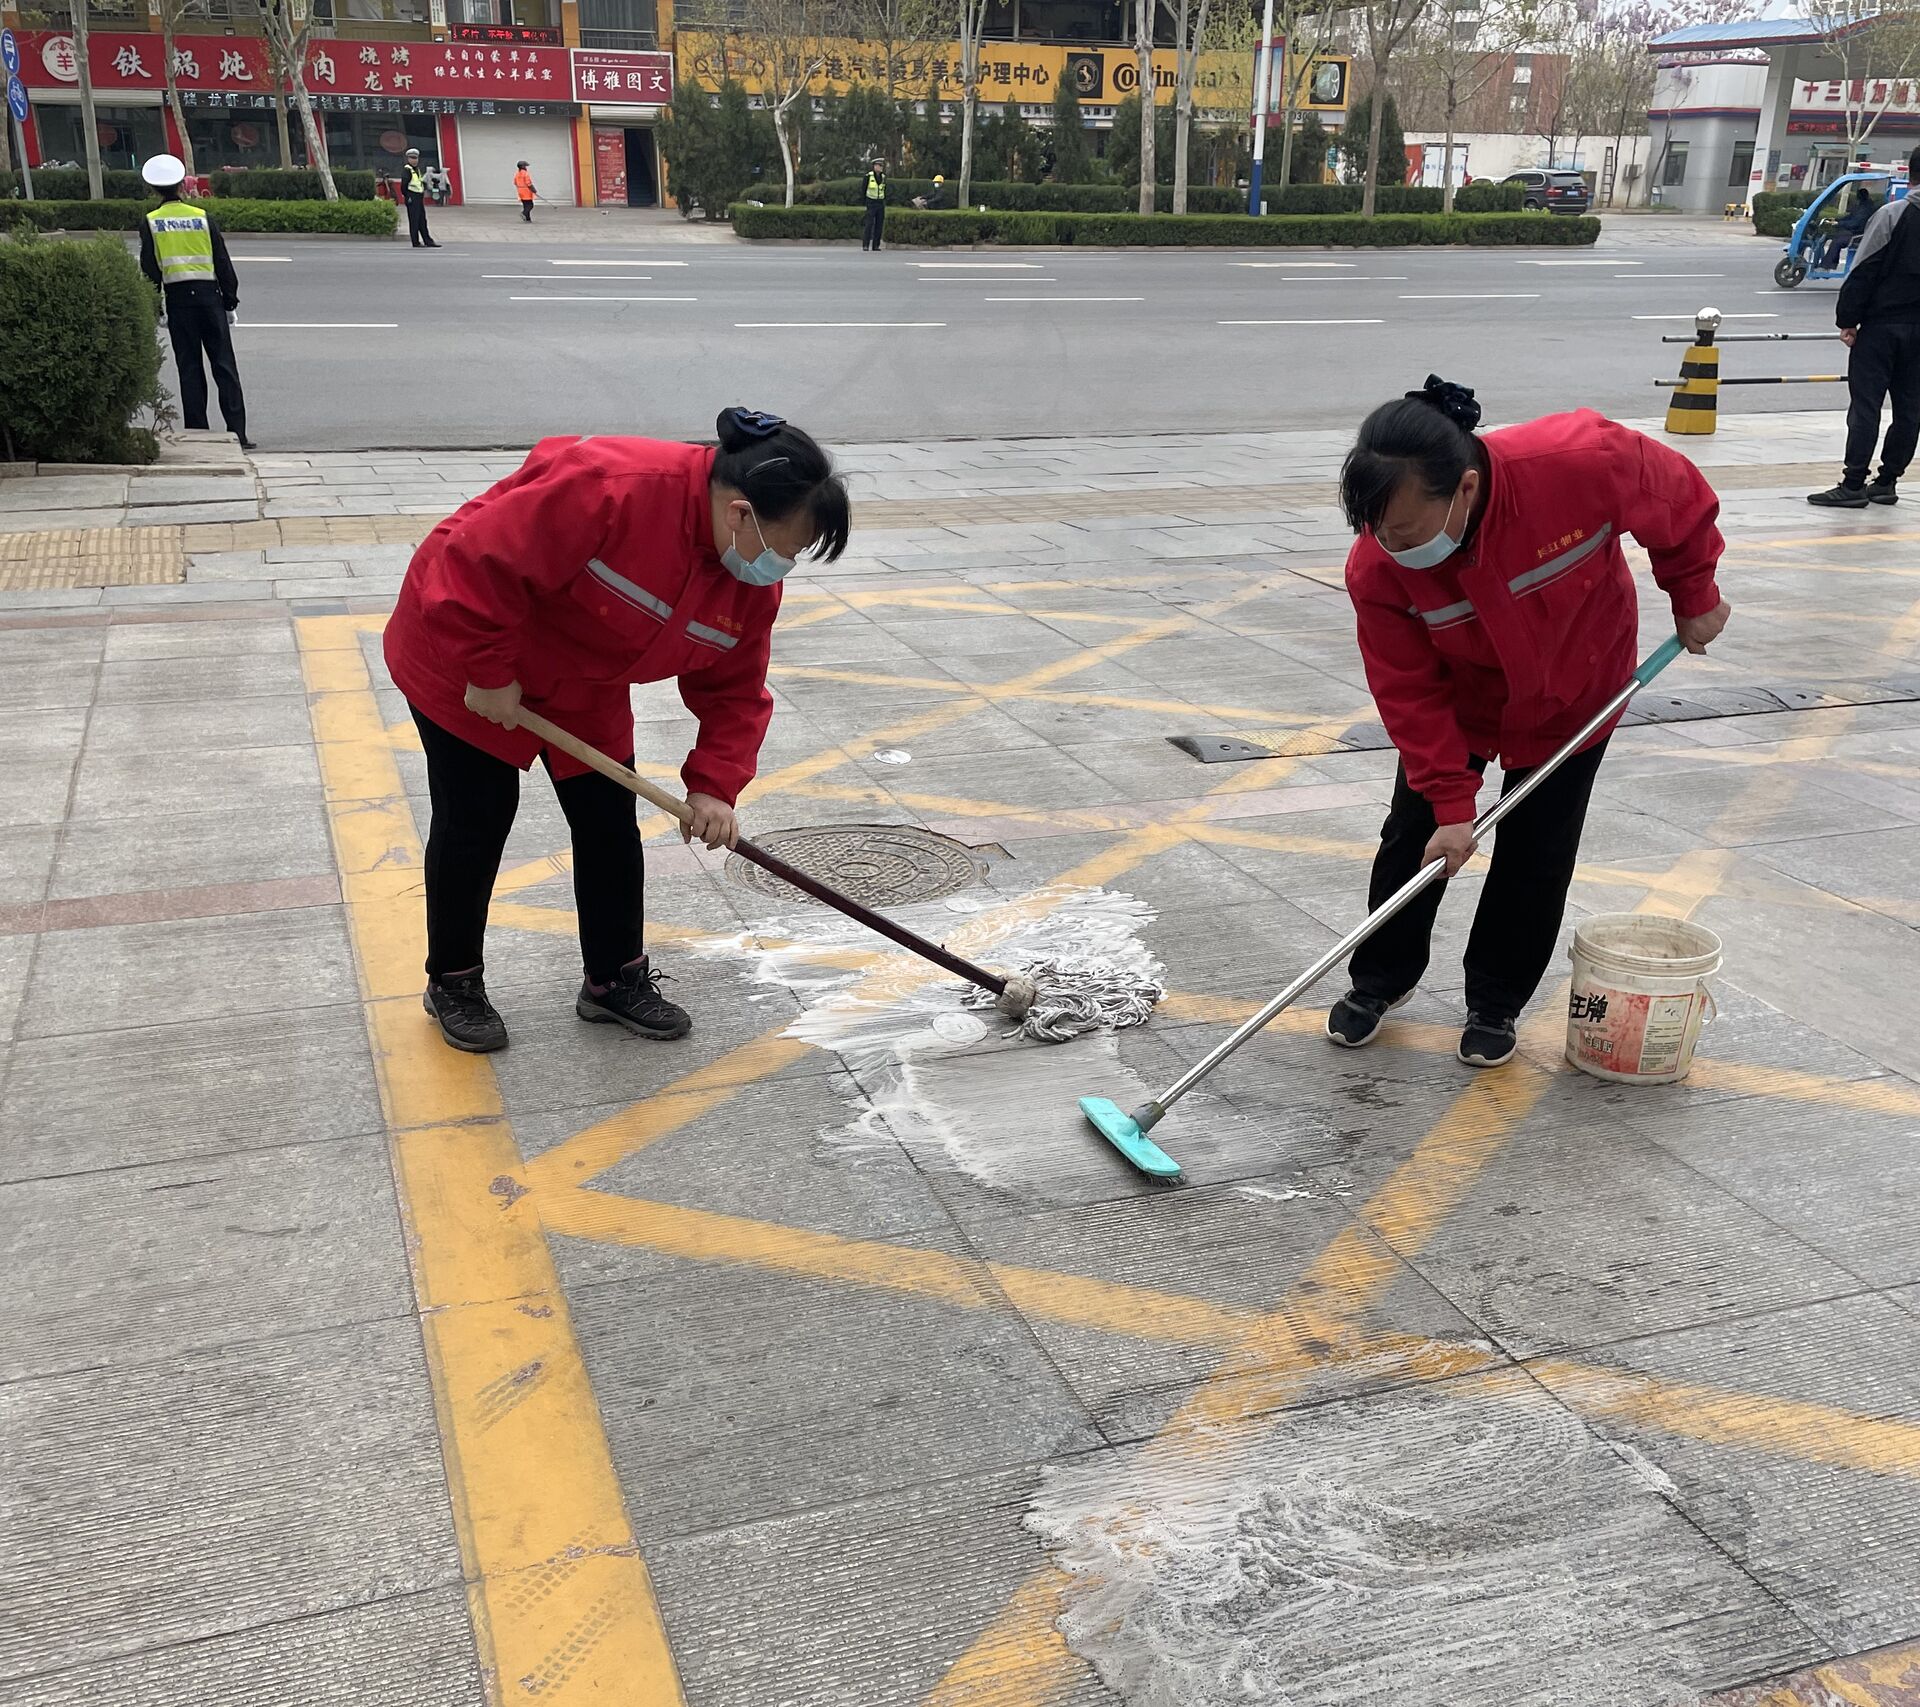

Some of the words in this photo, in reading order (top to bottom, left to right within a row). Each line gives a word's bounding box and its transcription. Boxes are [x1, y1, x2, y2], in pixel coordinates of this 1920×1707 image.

[56, 53, 74, 71] 羊
[111, 45, 335, 85] 铁锅炖肉
[359, 46, 410, 67] 烧烤
[364, 71, 413, 91] 龙虾
[581, 69, 667, 92] 博雅图文
